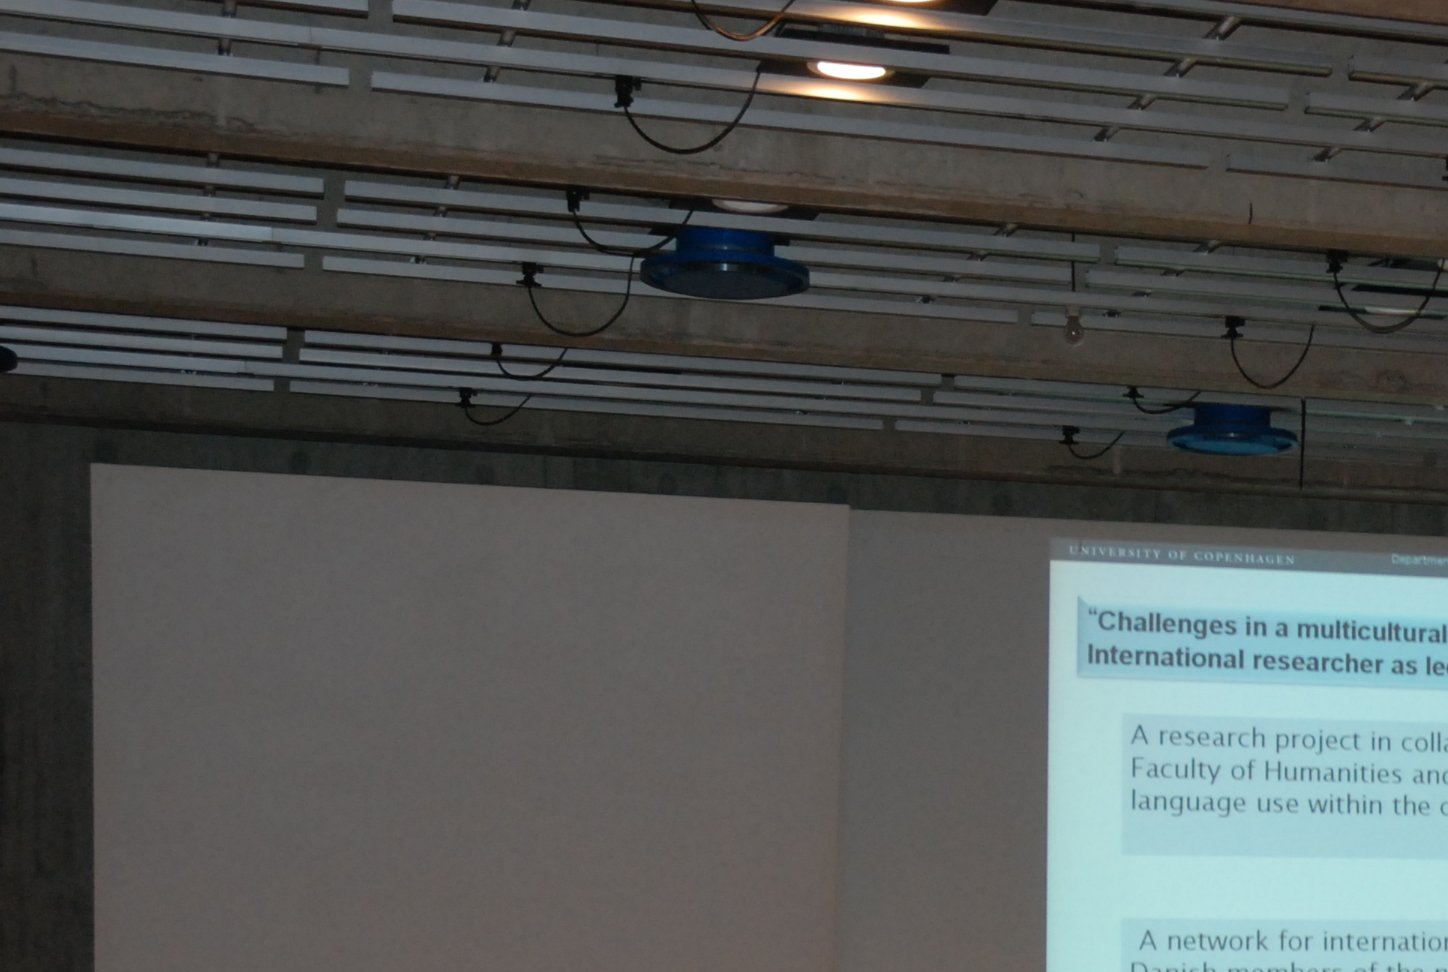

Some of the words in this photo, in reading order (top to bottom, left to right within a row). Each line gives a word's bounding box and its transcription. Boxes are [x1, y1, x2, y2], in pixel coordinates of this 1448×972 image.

[1069, 546, 1161, 560] UNIVERSITY
[1168, 551, 1187, 561] OF
[1194, 552, 1296, 566] COPENHAGEN
[1088, 608, 1237, 640] “Challenges
[1246, 616, 1267, 637] in
[1275, 622, 1288, 638] a
[1297, 620, 1447, 644] multicultural
[1088, 643, 1244, 669] International
[1253, 653, 1383, 675] researcher
[1391, 658, 1418, 675] as
[1130, 724, 1149, 746] A
[1158, 726, 1266, 748] research
[1275, 729, 1361, 755] project
[1371, 731, 1392, 752] in
[1131, 756, 1221, 785] Faculty
[1231, 759, 1256, 781] of
[1265, 760, 1402, 784] Humanities
[1131, 789, 1246, 817] language
[1257, 796, 1299, 813] use
[1308, 793, 1383, 816] within
[1392, 795, 1431, 817] the
[1139, 929, 1157, 951] A
[1167, 929, 1269, 951] network
[1279, 928, 1313, 951] for
